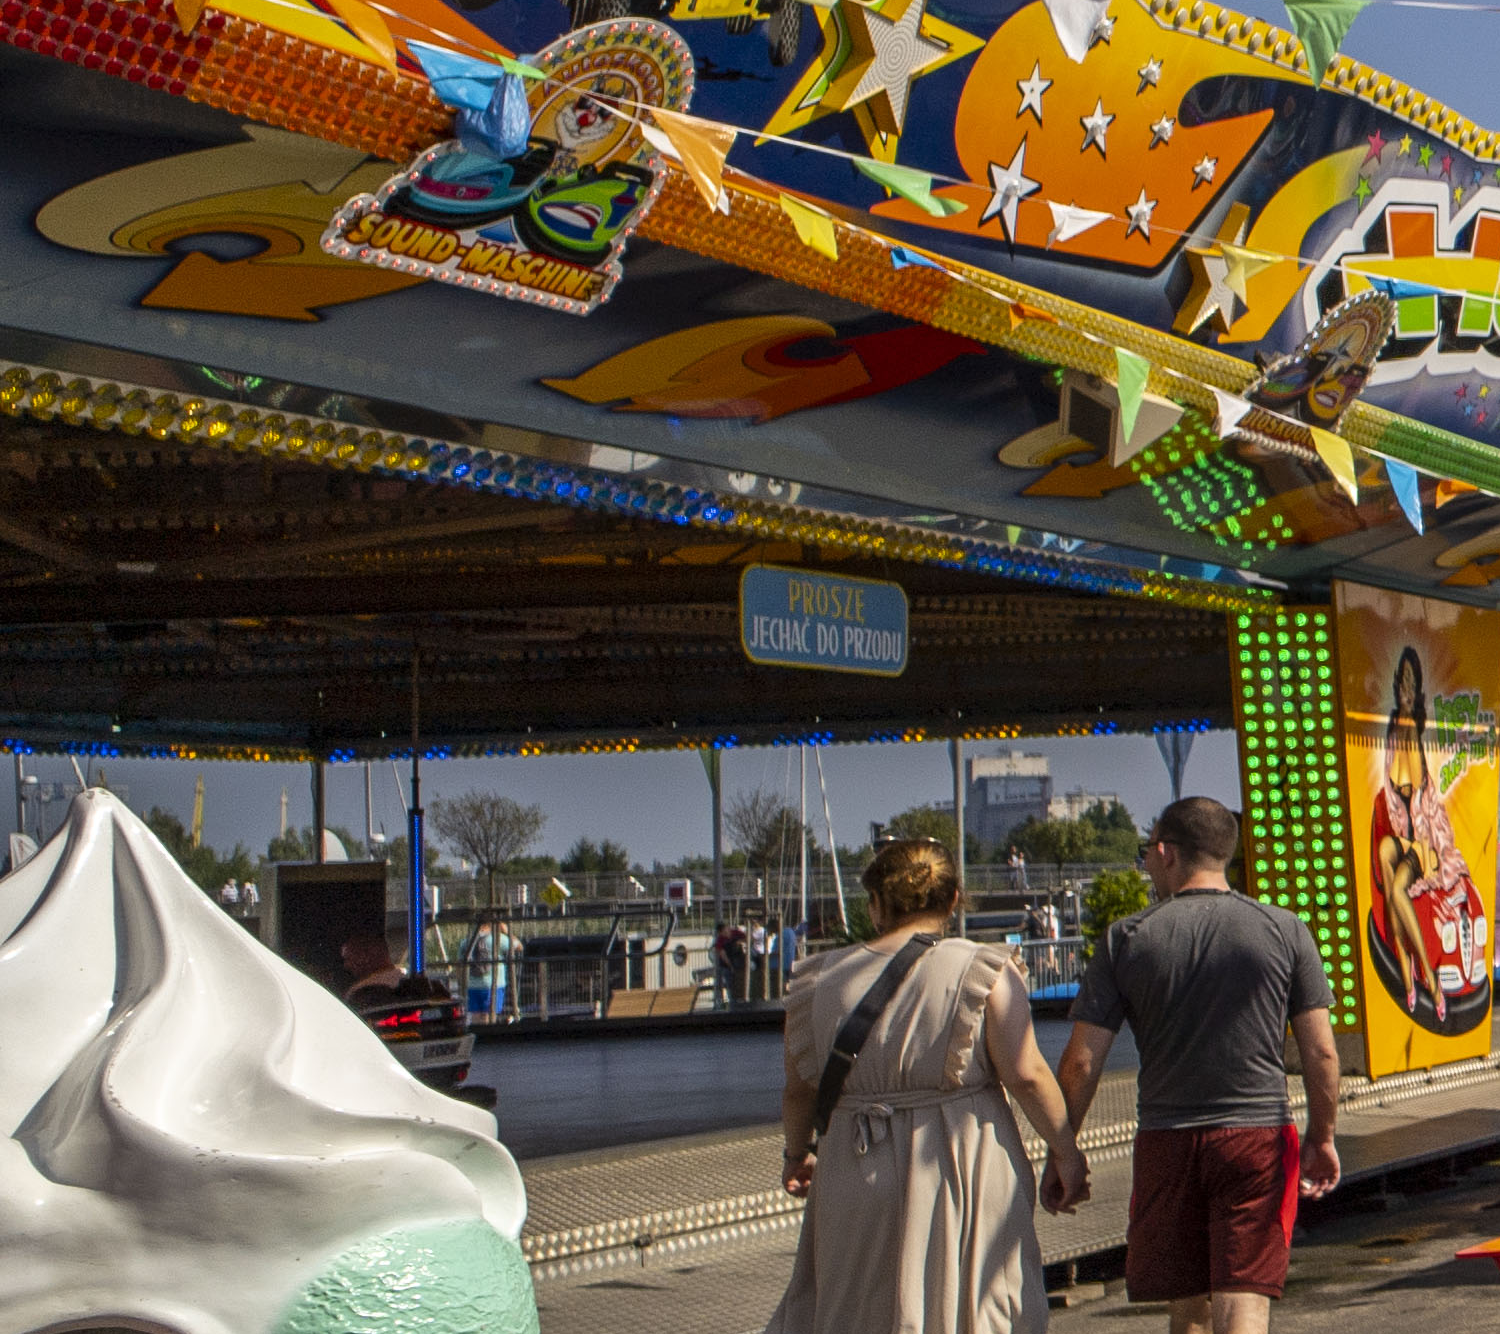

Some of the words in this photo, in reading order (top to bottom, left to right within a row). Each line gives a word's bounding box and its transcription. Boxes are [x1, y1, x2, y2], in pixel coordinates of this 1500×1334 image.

[345, 213, 608, 302] SOUND-MASCHINE
[788, 578, 865, 624] PROSZĘ
[750, 615, 812, 654] JECHAĆ
[816, 621, 839, 656] DO
[844, 625, 901, 662] PRZODU
